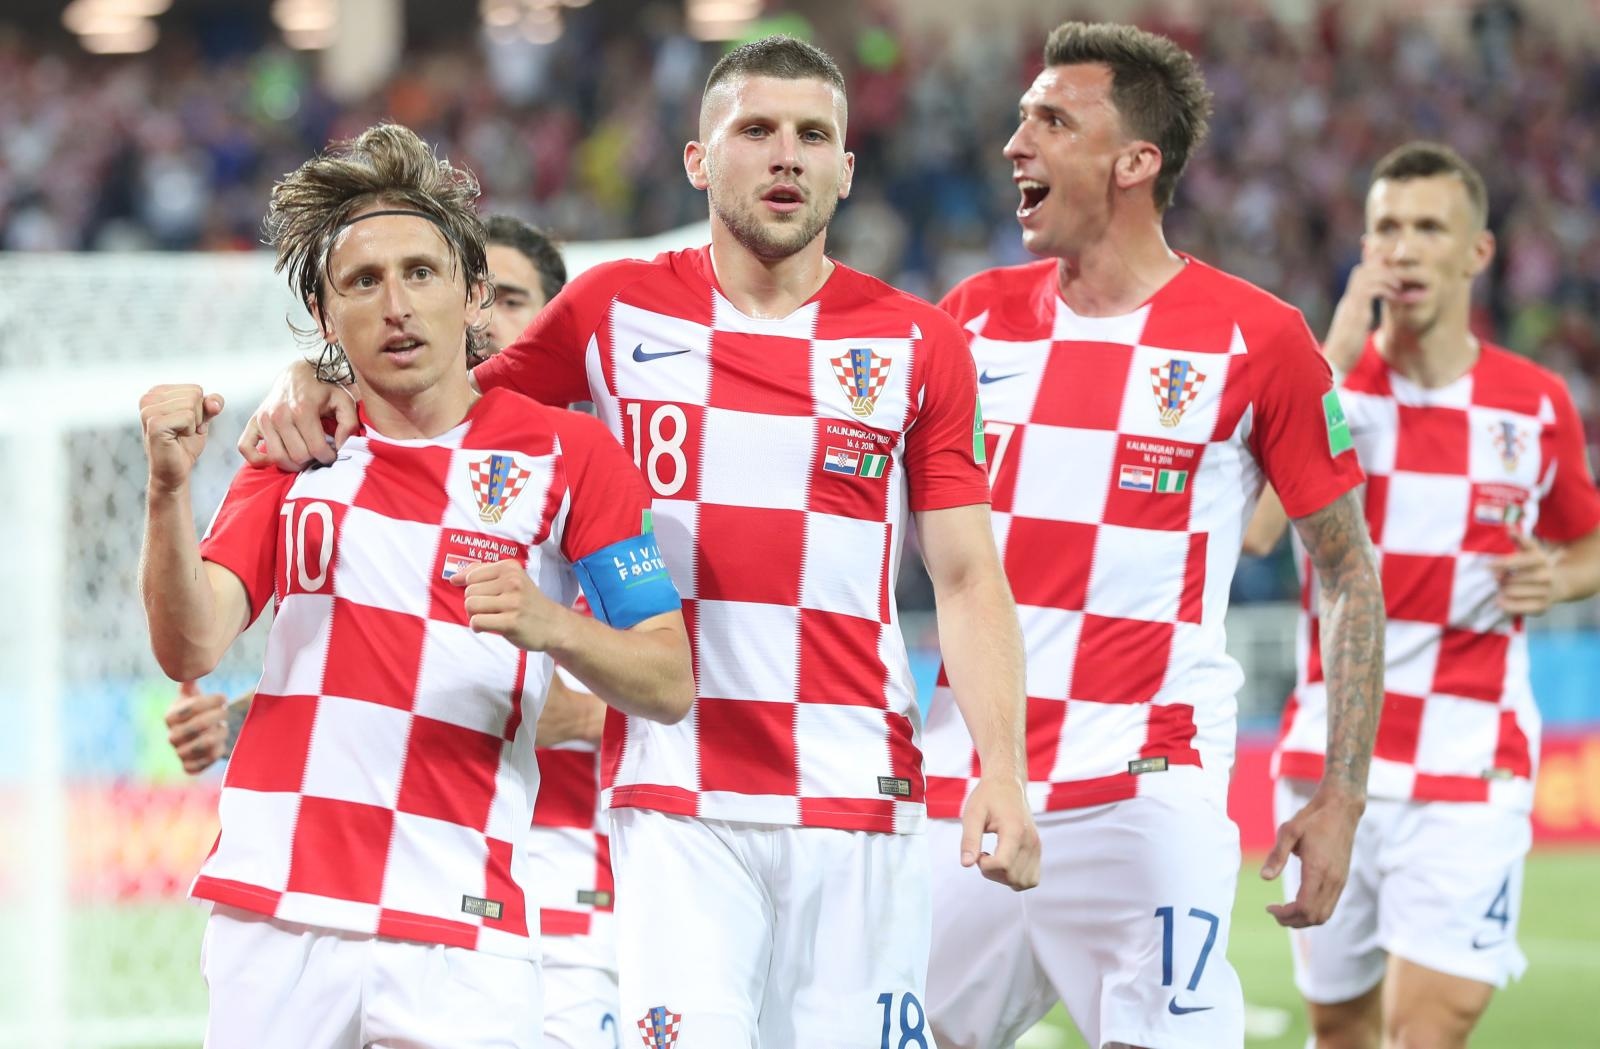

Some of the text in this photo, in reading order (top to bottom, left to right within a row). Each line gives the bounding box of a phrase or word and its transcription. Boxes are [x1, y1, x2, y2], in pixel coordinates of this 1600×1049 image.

[855, 354, 866, 388] HNS
[626, 402, 688, 496] 18
[983, 420, 1016, 490] 7
[280, 501, 334, 592] 10
[450, 534, 499, 551] KALINJINGRAD
[1485, 878, 1510, 930] 4
[1154, 906, 1219, 992] 17
[876, 991, 928, 1049] 18
